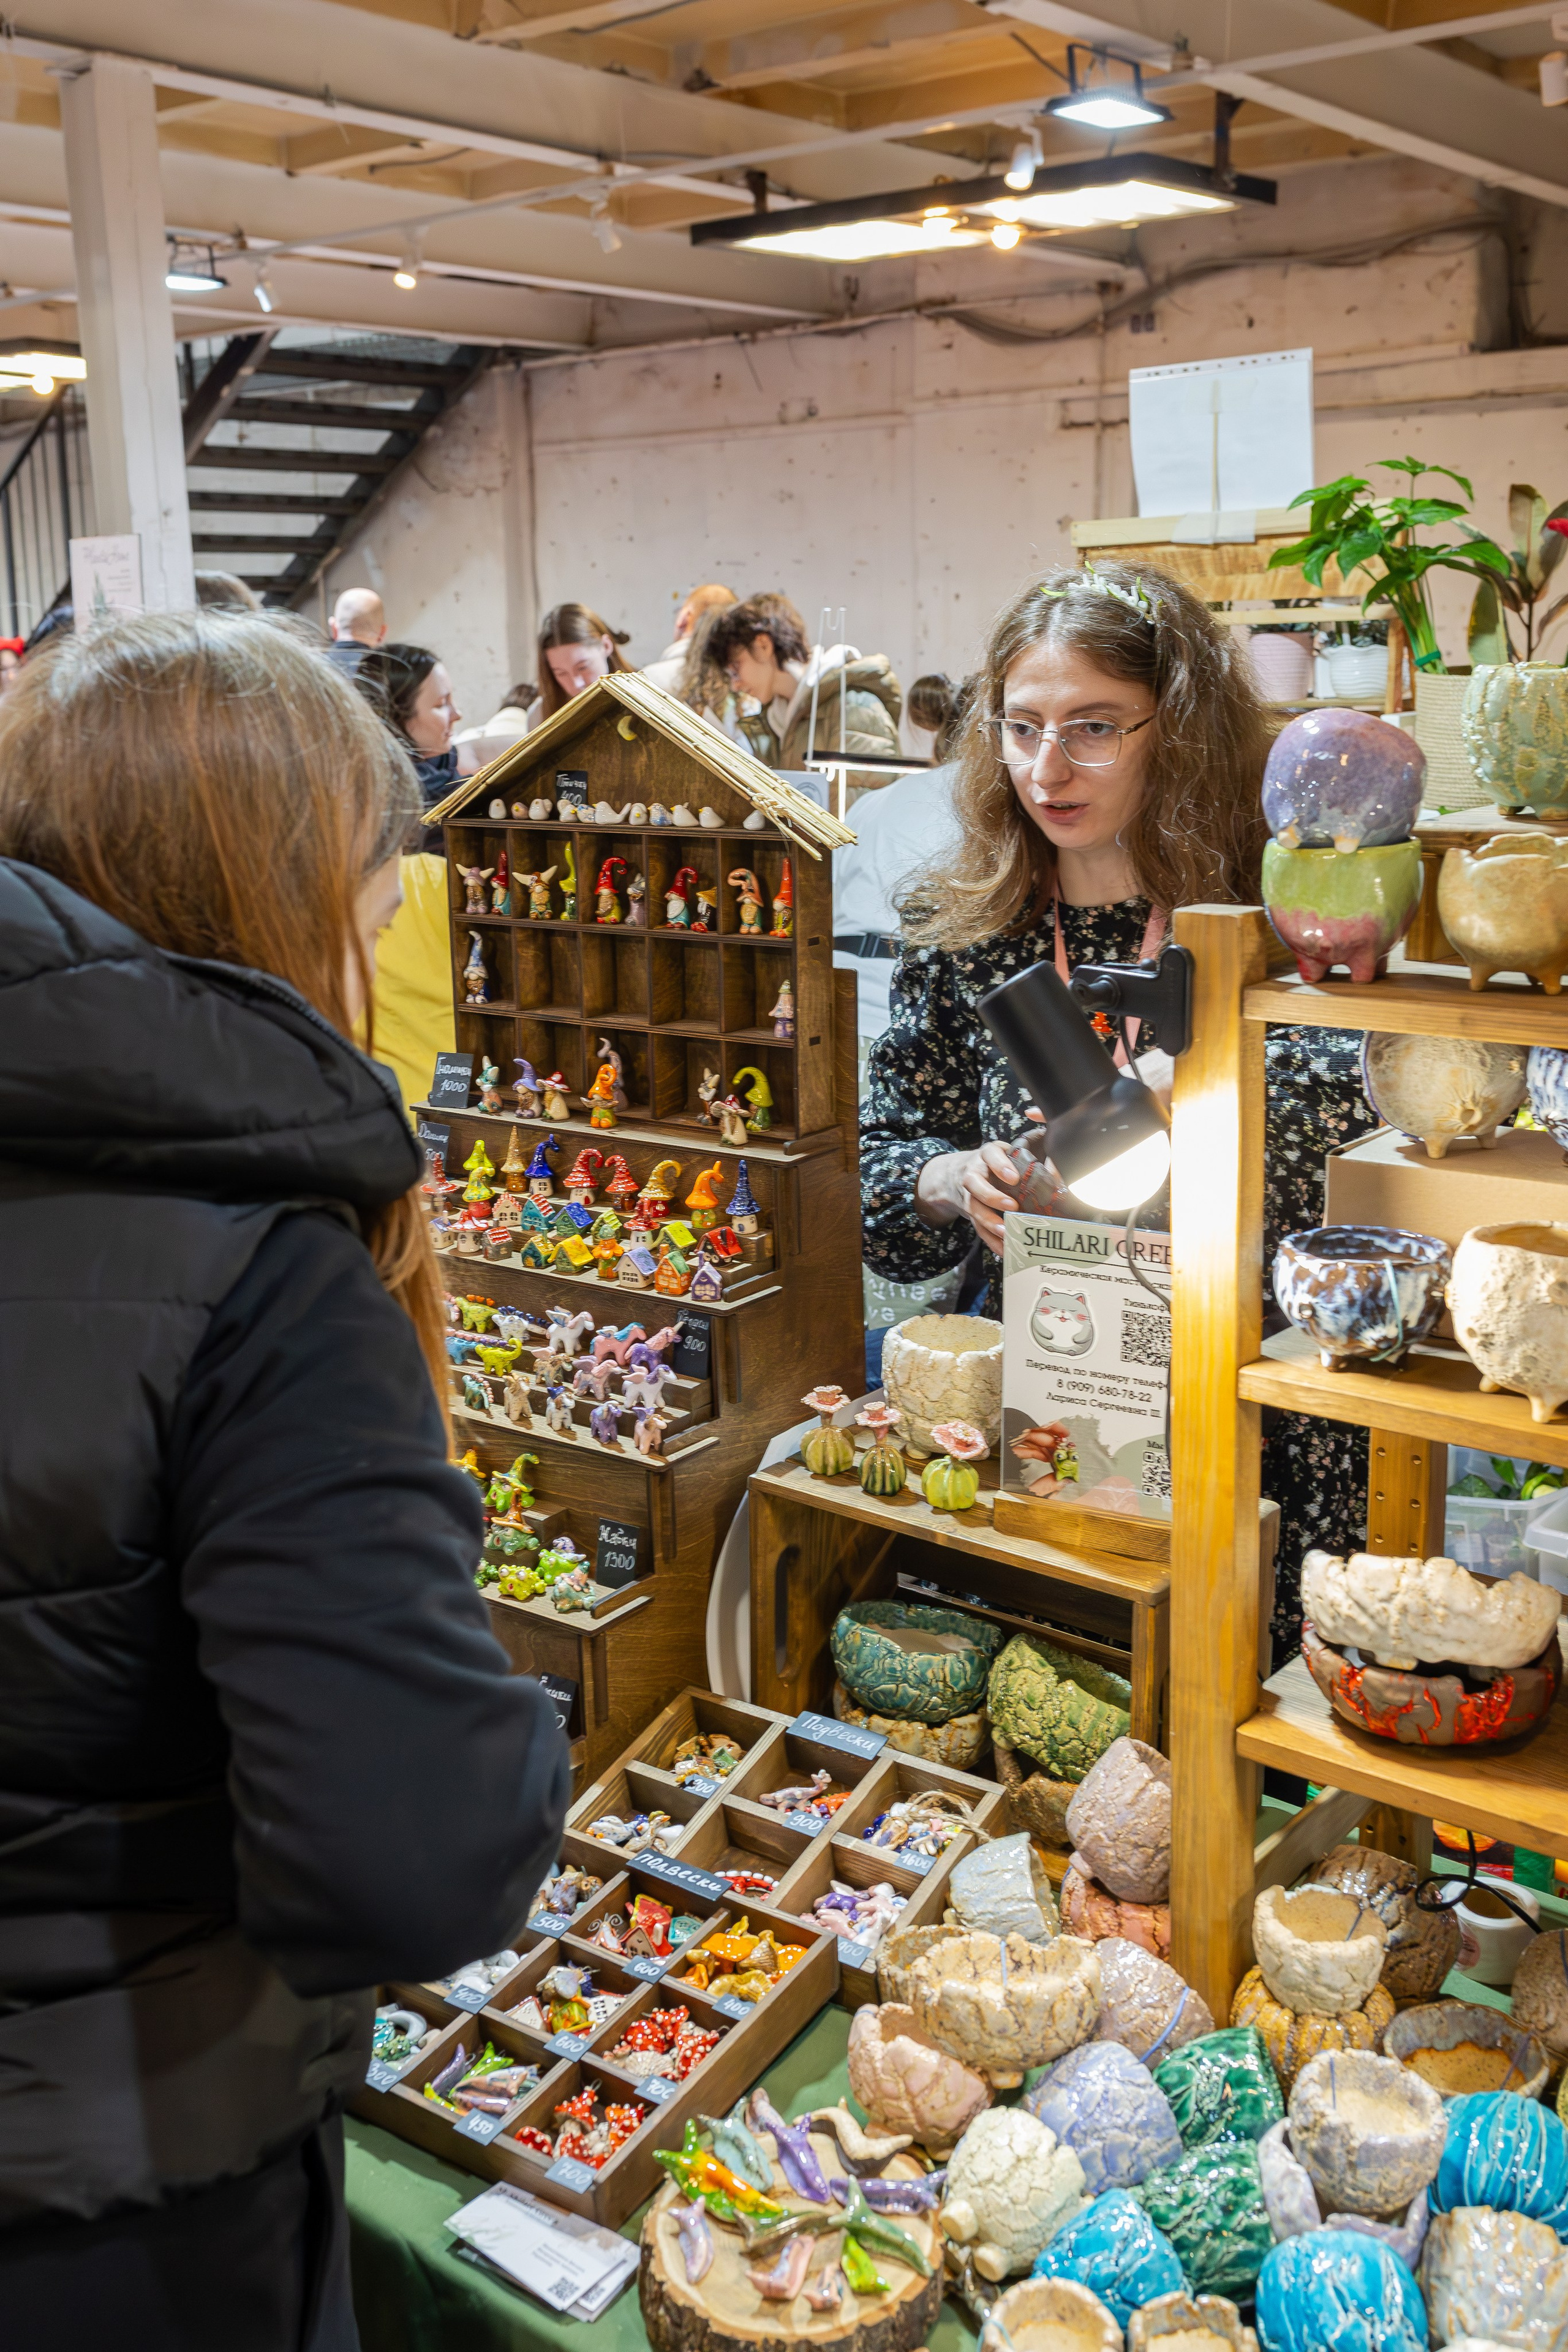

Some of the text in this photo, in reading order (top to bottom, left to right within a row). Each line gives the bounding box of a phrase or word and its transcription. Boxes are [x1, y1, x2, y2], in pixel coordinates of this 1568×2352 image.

[440, 1079, 467, 1093] 1000
[1023, 1227, 1111, 1256] SHILARI
[1039, 1265, 1112, 1282] Керамическая
[683, 1336, 707, 1352] 900
[1025, 1359, 1071, 1375] Перевод
[1073, 1368, 1087, 1376] по
[1089, 1371, 1131, 1385] номеру
[1056, 1379, 1153, 1403] 8 (909) 680-78-22
[1046, 1392, 1088, 1406] Лариса
[1088, 1399, 1147, 1416] Сергеевна
[604, 1551, 636, 1570] 1300
[801, 1715, 876, 1751] Подвески
[789, 1814, 823, 1830] 900
[900, 1853, 931, 1869] 1600
[533, 1916, 566, 1931] 500
[633, 1962, 661, 1977] 600
[723, 1998, 751, 2015] 400
[555, 2035, 585, 2052] 600
[366, 2062, 398, 2086] 300
[467, 2113, 495, 2135] 450
